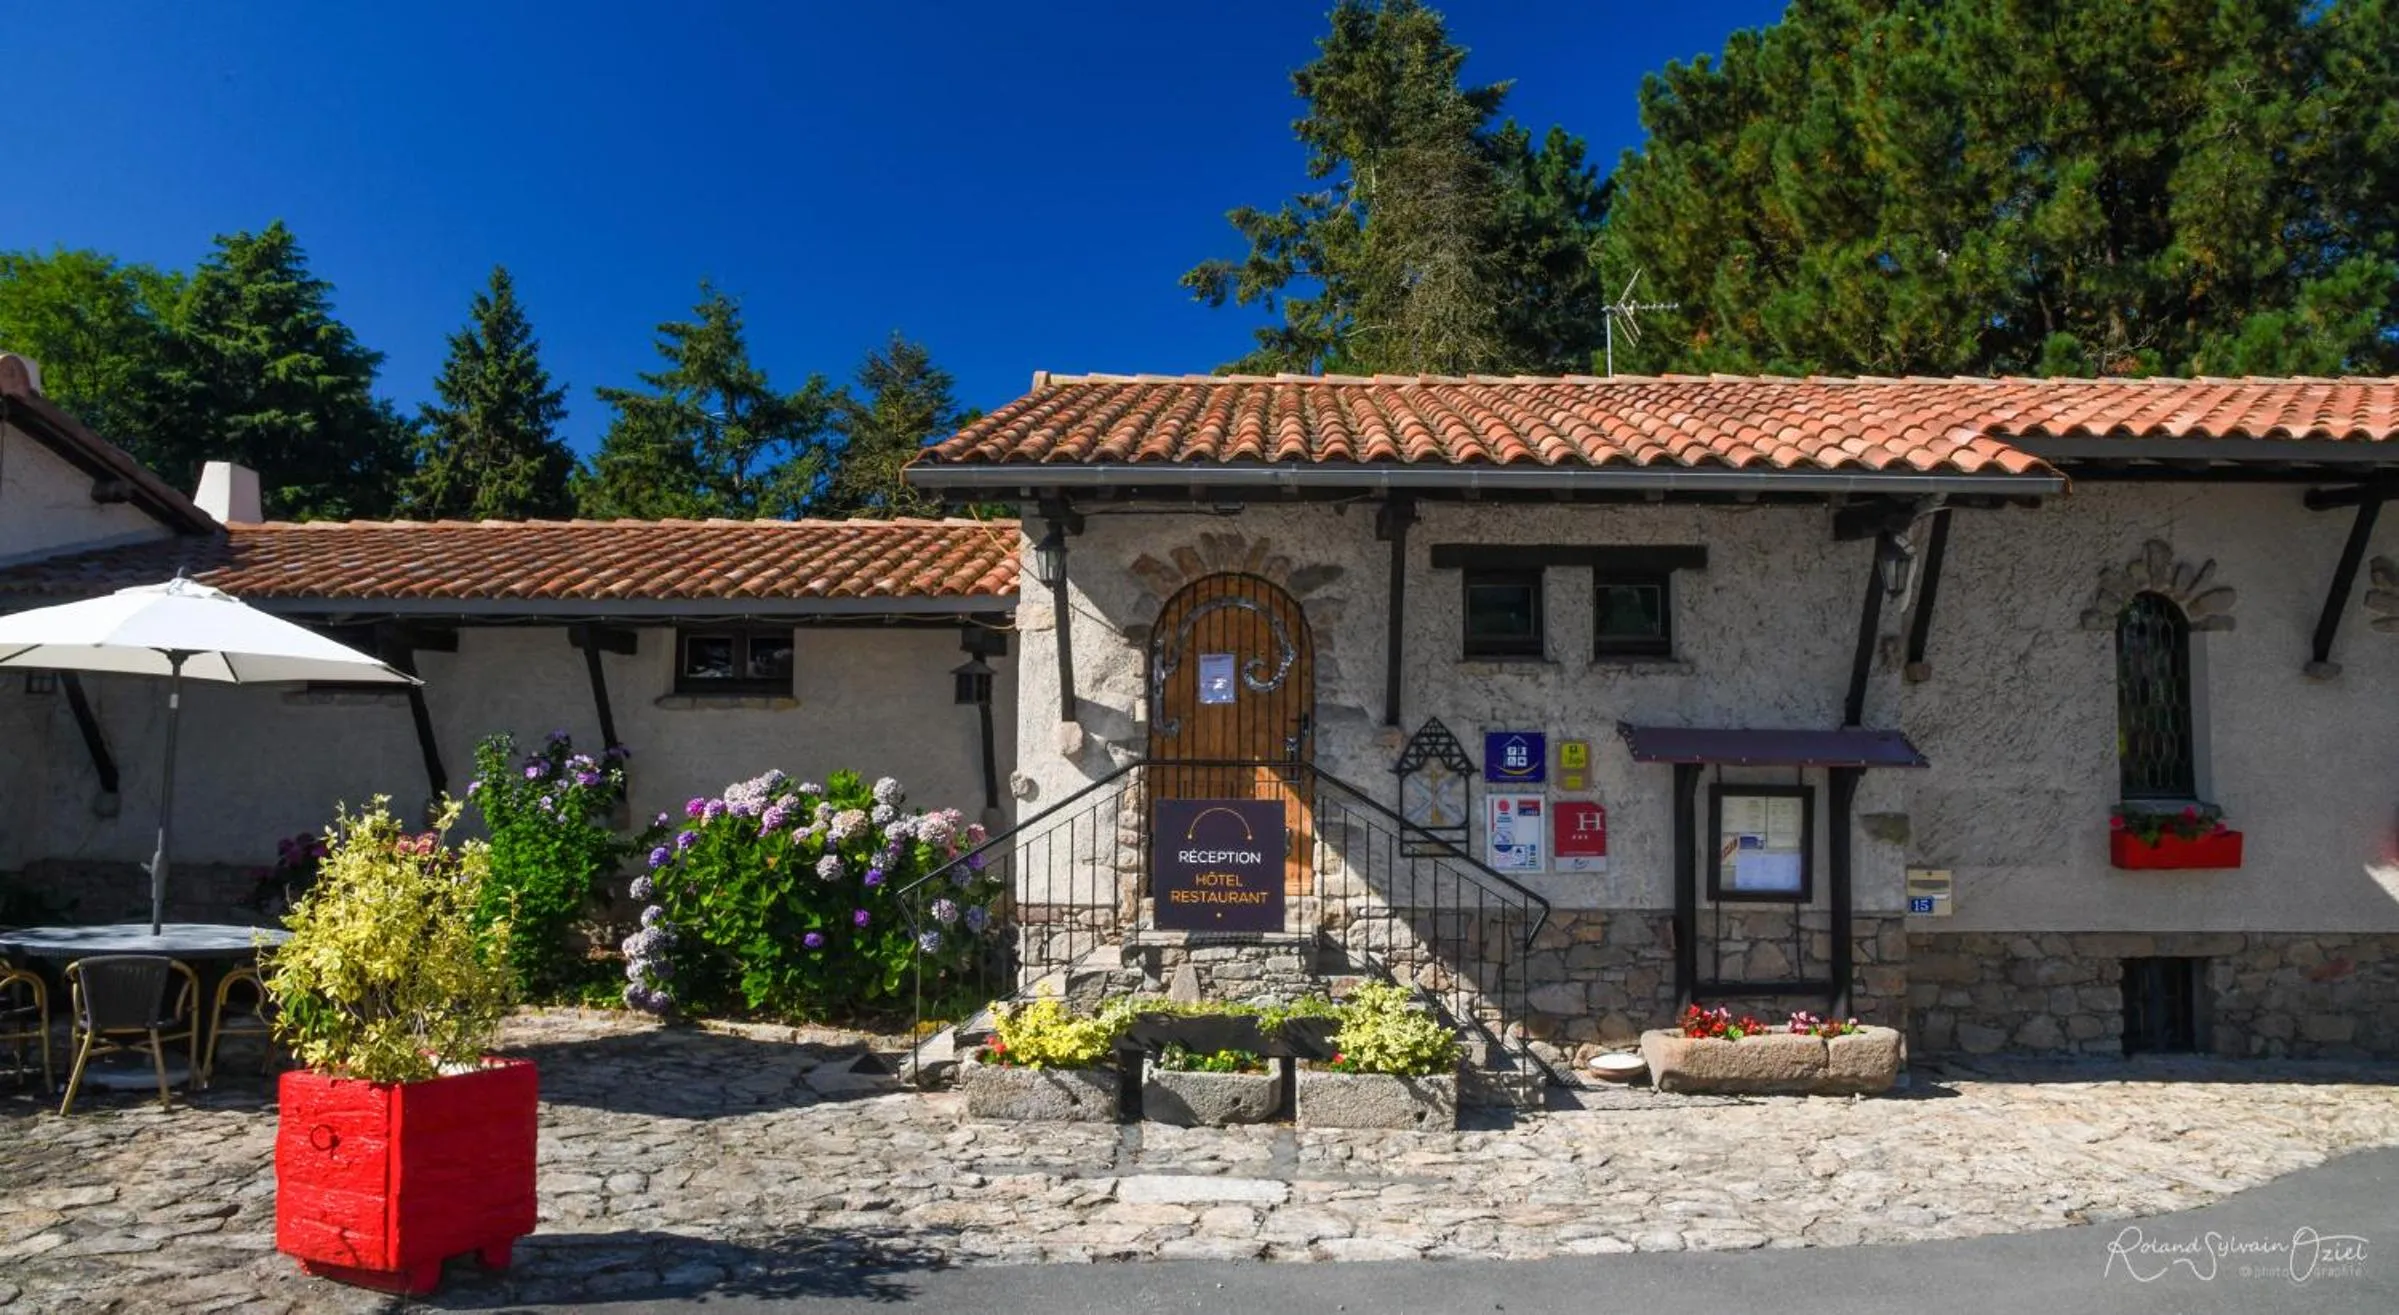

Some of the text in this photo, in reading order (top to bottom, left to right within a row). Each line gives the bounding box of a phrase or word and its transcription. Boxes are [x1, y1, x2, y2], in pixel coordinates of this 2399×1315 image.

[1575, 811, 1603, 831] H
[1177, 848, 1262, 864] RÉCEPTION
[1195, 871, 1244, 887] HÔTEL
[1170, 890, 1269, 904] RESTAURANT
[1914, 899, 1930, 912] 15
